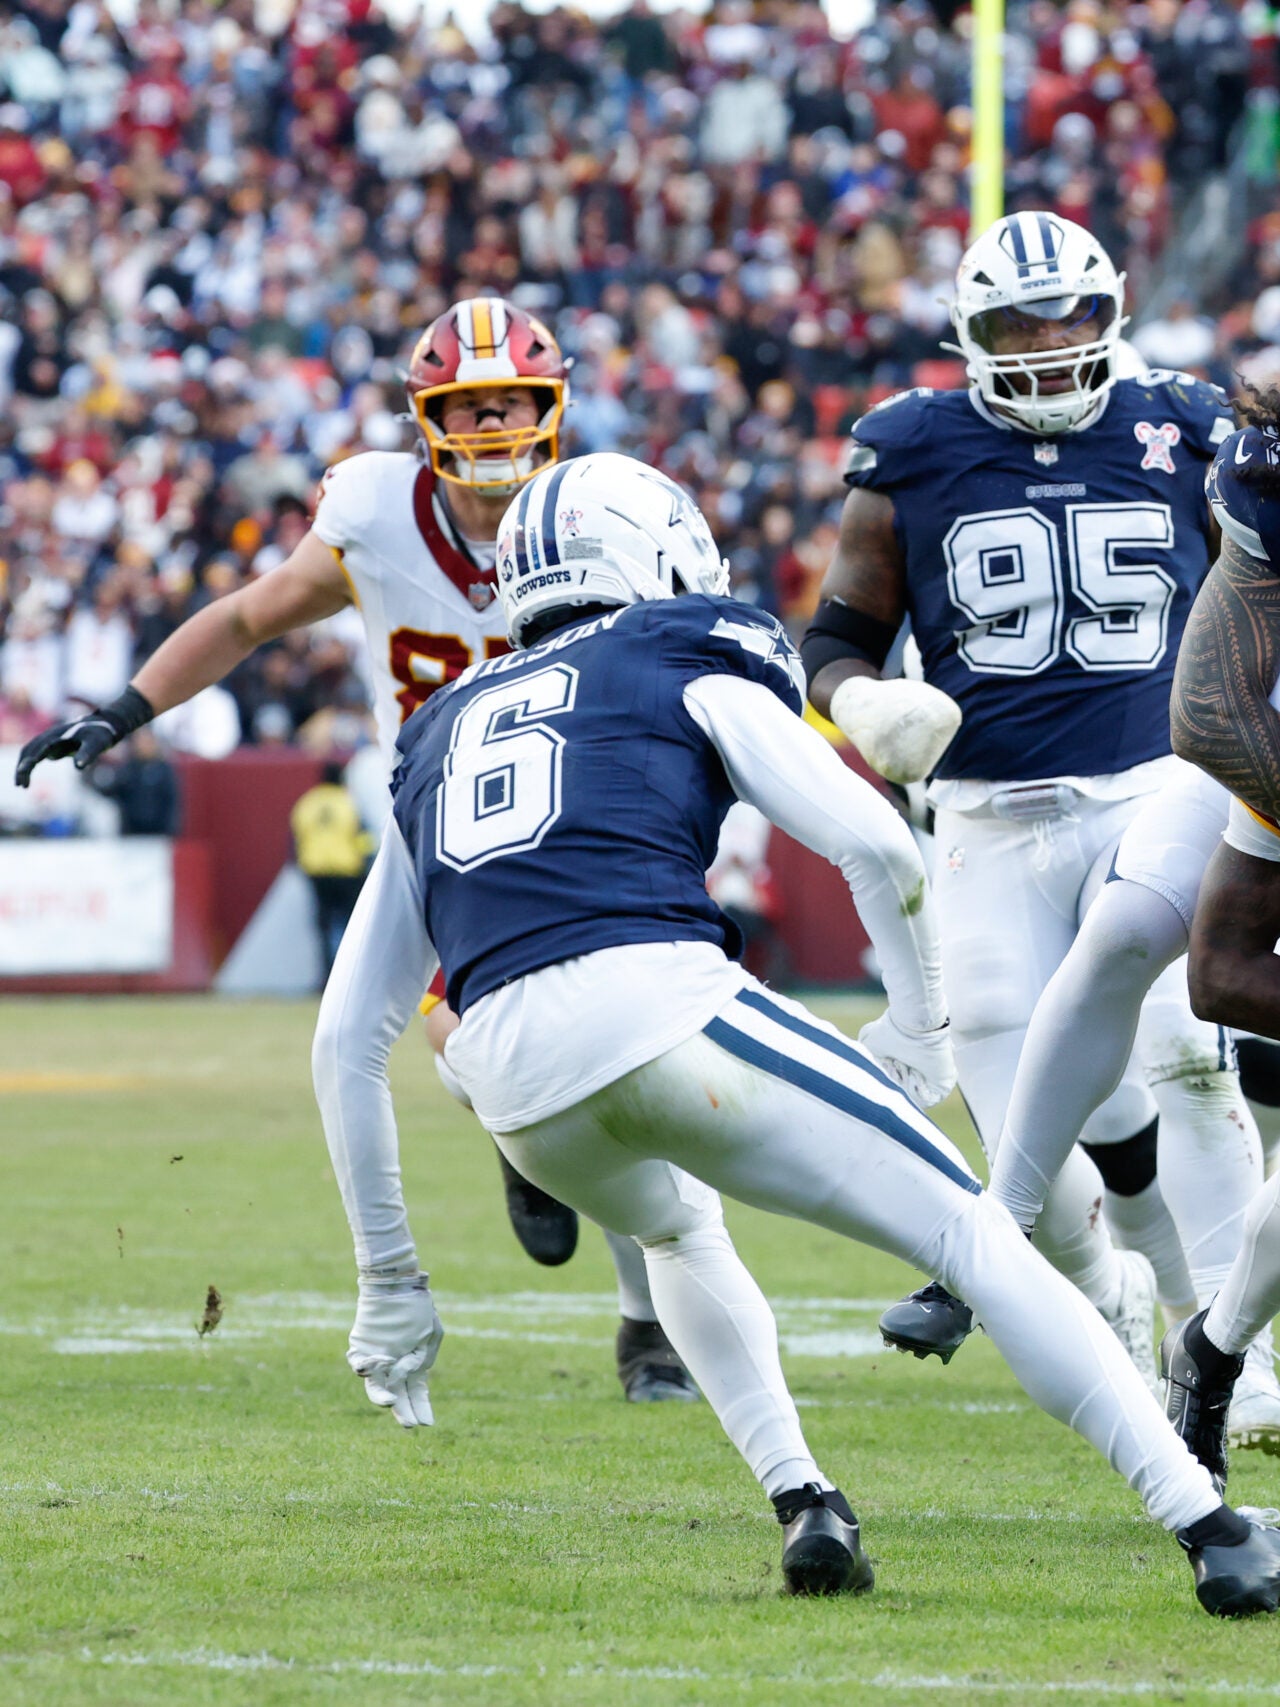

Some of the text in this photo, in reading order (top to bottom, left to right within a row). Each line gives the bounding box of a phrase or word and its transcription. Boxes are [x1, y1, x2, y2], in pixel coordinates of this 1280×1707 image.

[516, 571, 571, 599] COWBOYS
[942, 501, 1177, 676] 95
[436, 661, 580, 874] 6
